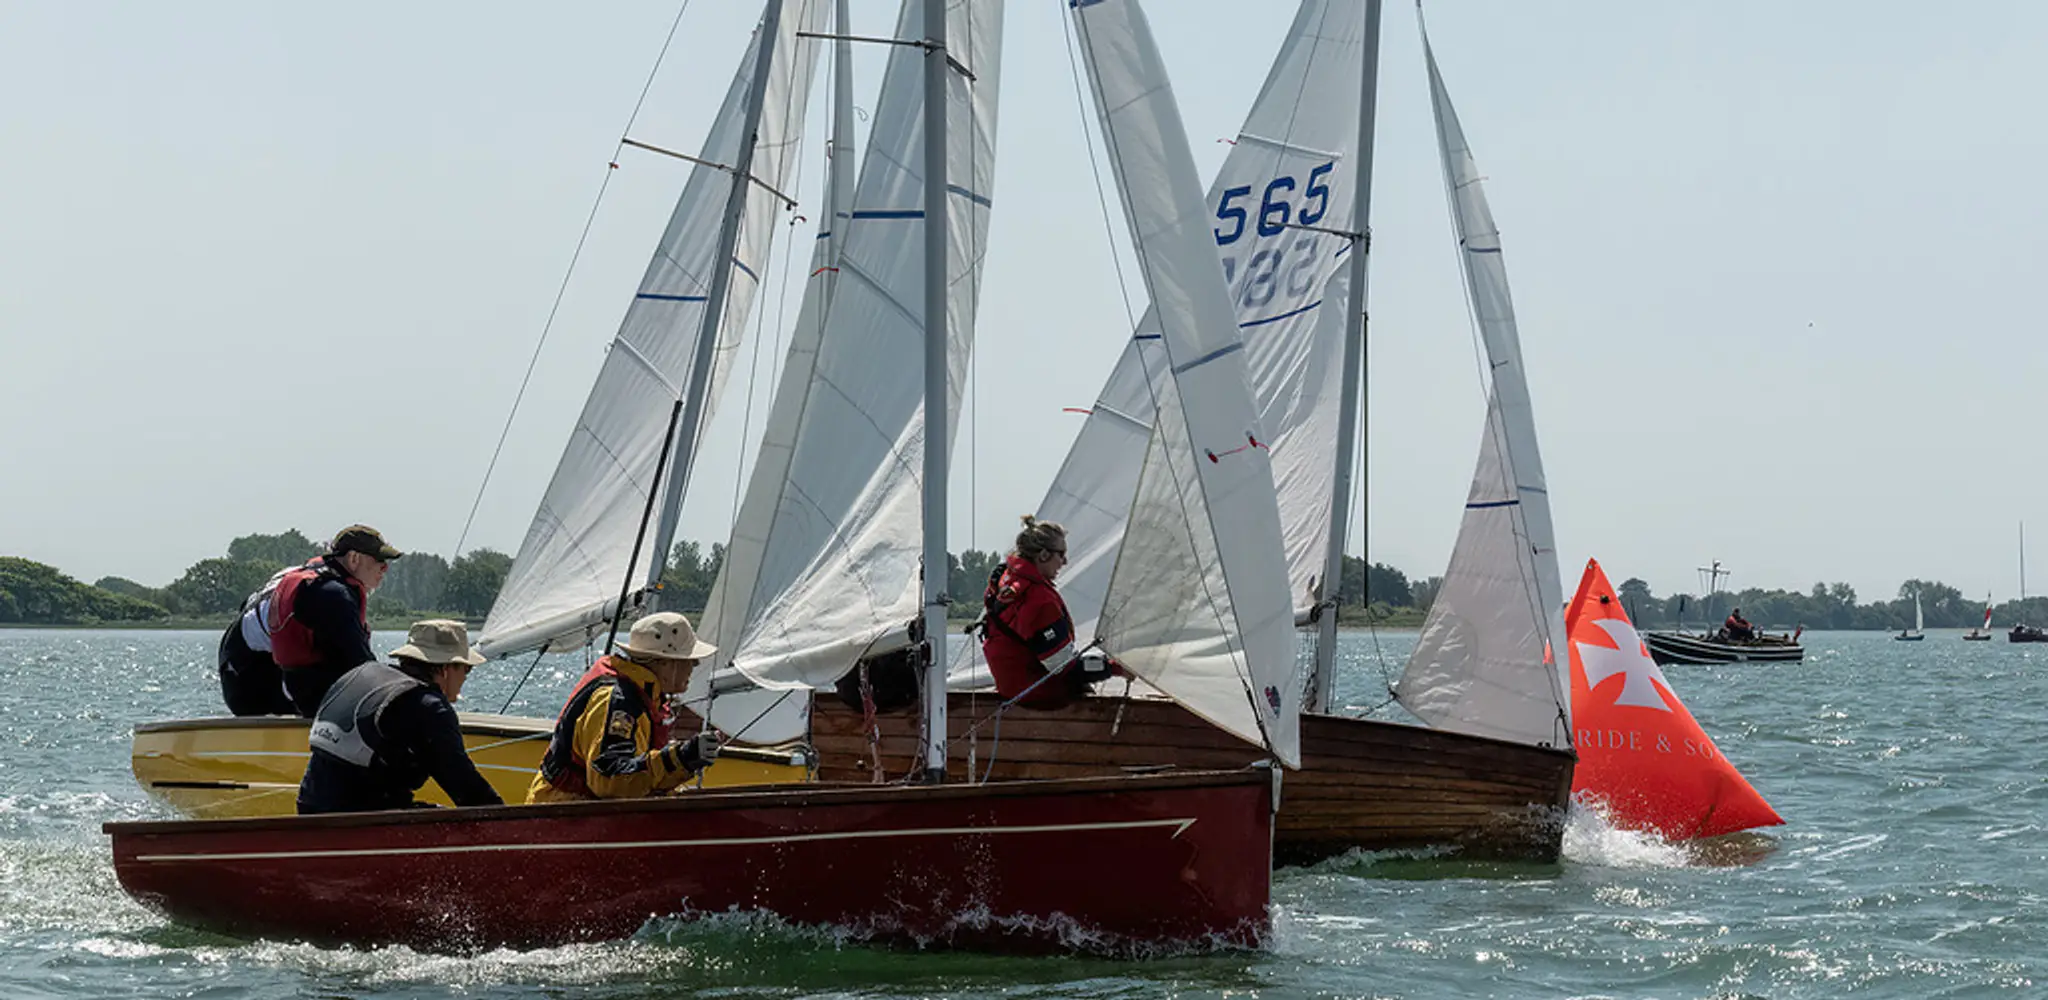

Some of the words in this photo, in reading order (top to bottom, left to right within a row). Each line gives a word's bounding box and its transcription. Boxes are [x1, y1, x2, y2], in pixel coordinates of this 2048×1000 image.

[1214, 162, 1333, 245] 565
[1577, 729, 1642, 750] RIDE
[1656, 734, 1672, 753] &
